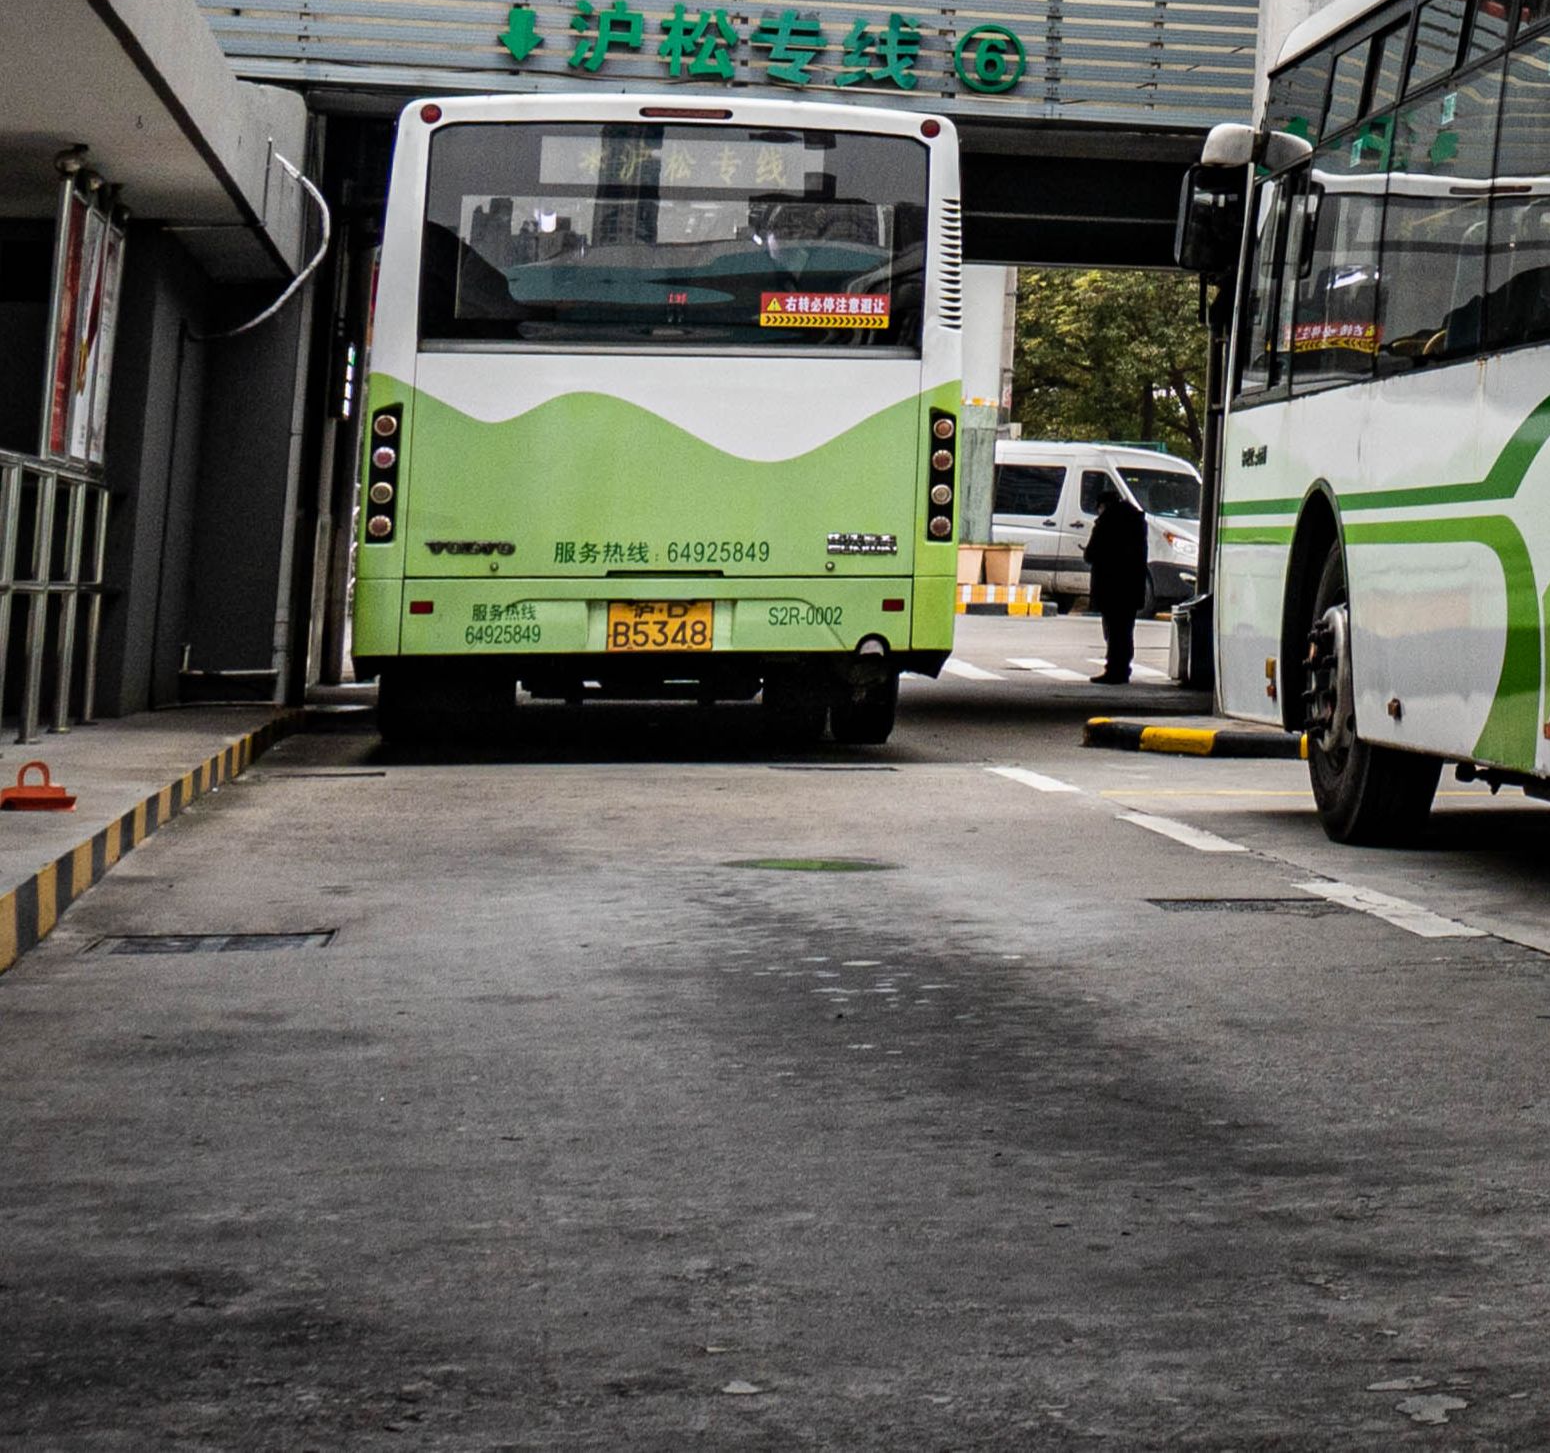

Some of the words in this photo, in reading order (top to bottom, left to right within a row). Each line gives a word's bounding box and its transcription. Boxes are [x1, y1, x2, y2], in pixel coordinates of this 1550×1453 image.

[567, 0, 922, 91] 沪松专线
[785, 296, 885, 314] 右转必停注意避让
[472, 603, 536, 622] 服务热线
[768, 606, 843, 626] S2R-0002
[465, 623, 541, 645] 64925849
[613, 620, 707, 647] B5348
